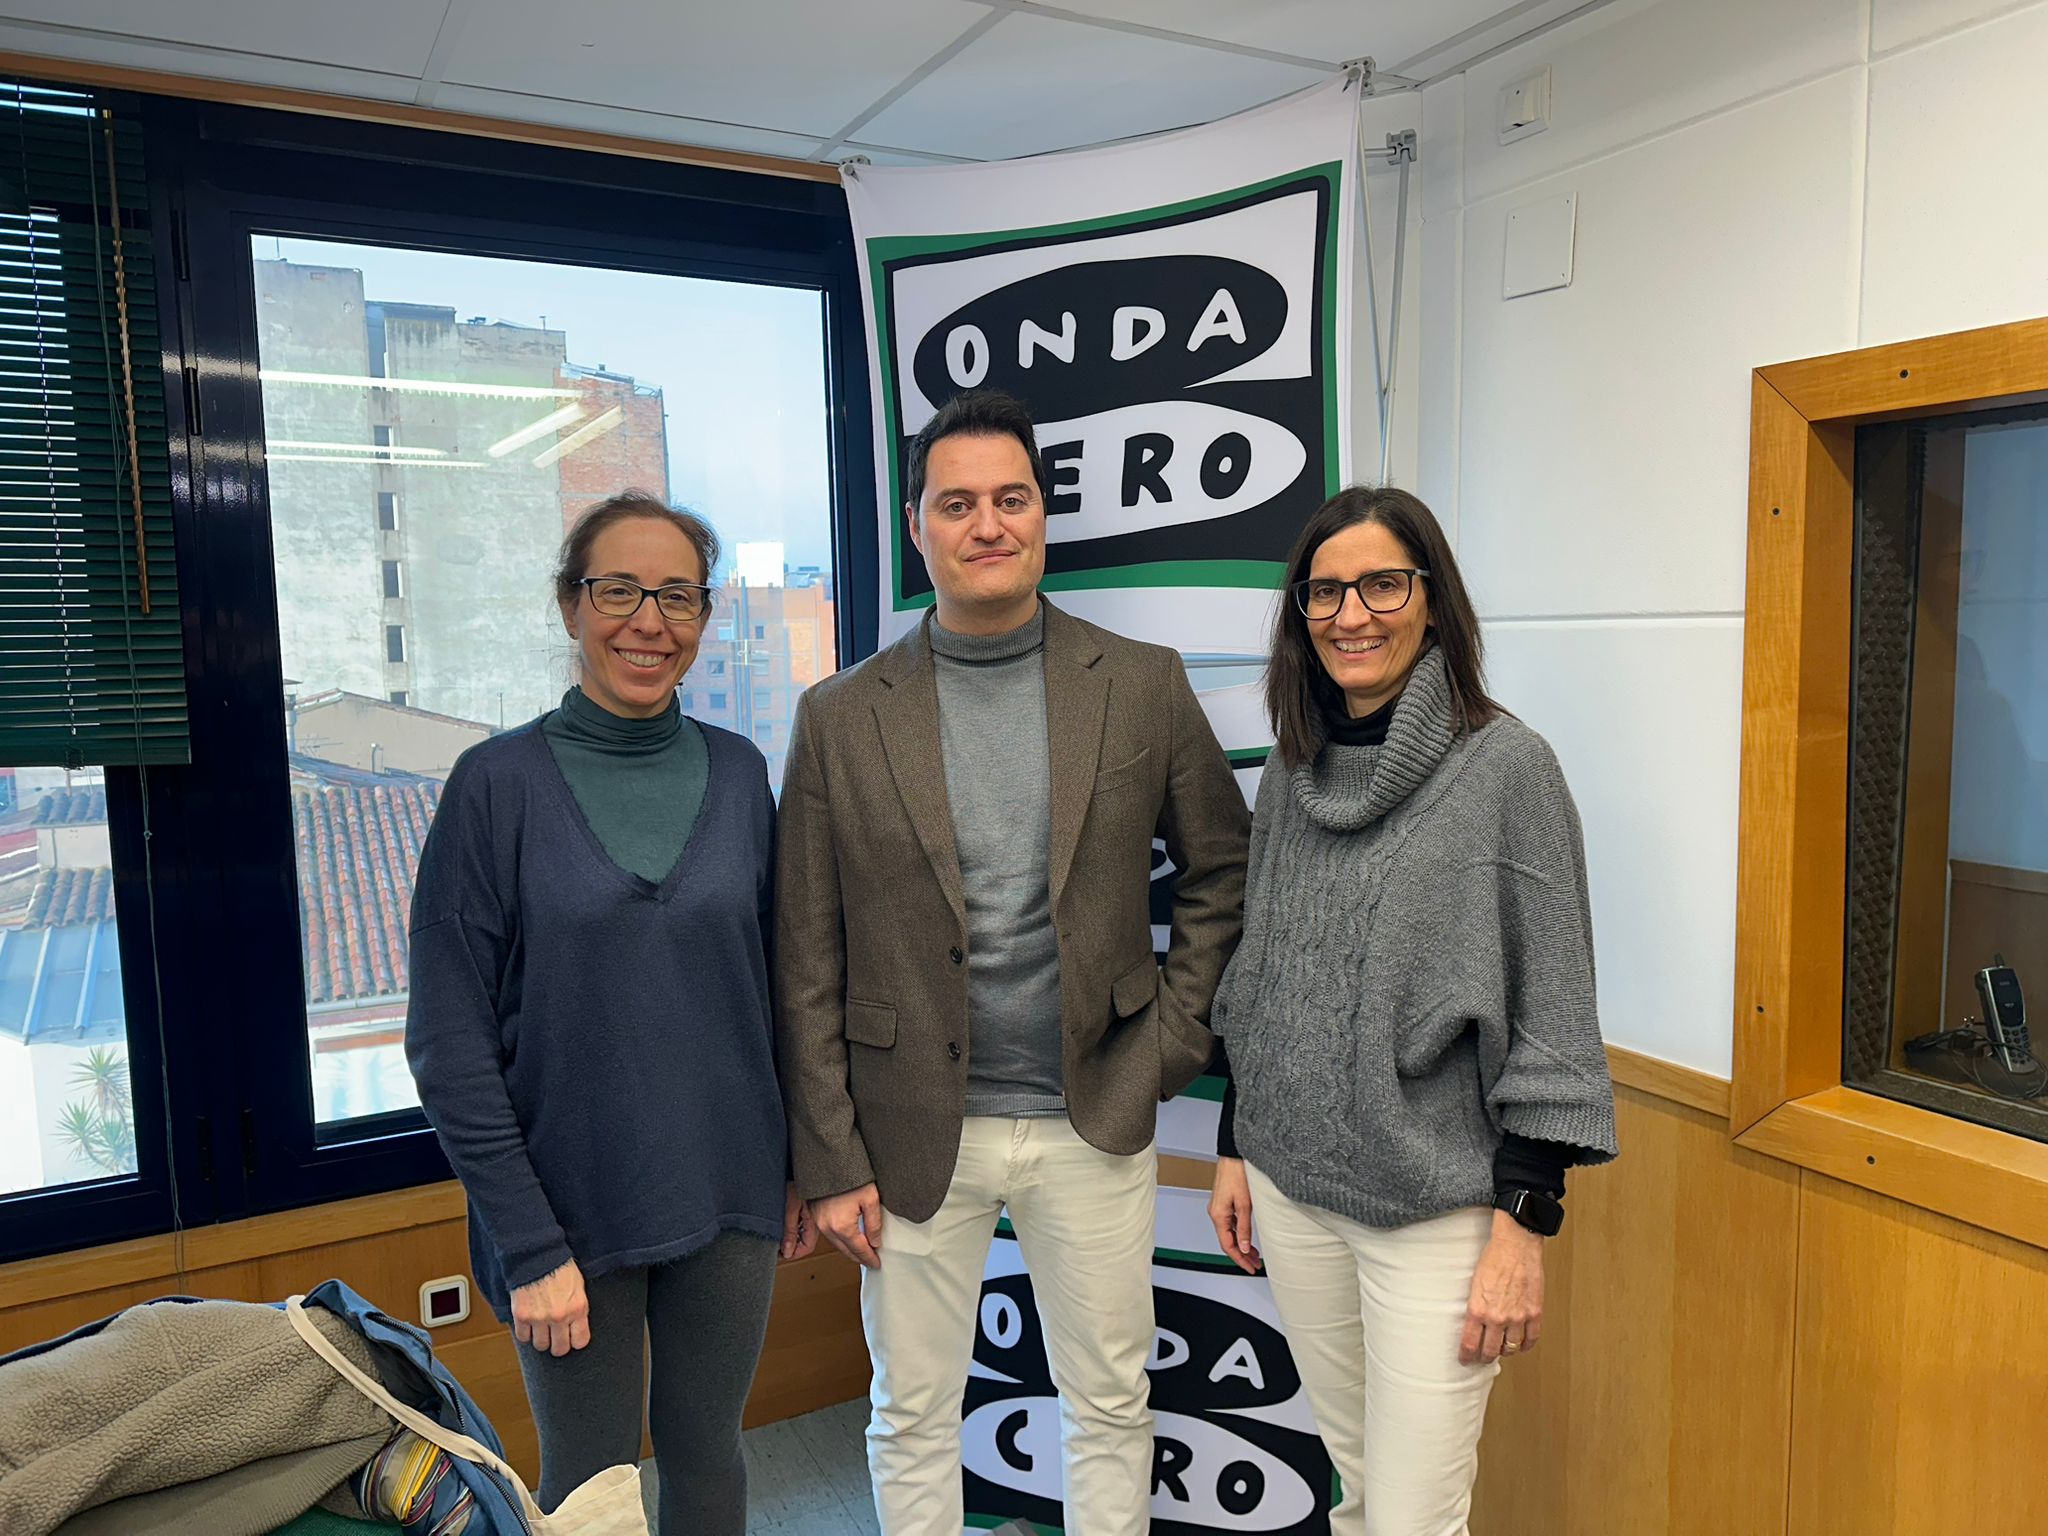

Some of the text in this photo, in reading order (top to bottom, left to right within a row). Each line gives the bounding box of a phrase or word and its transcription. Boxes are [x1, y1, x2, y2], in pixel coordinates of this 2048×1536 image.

[945, 289, 1246, 388] ONDA
[1041, 432, 1251, 513] ERO
[981, 1293, 1265, 1390] ODA
[995, 1409, 1265, 1515] CRO
